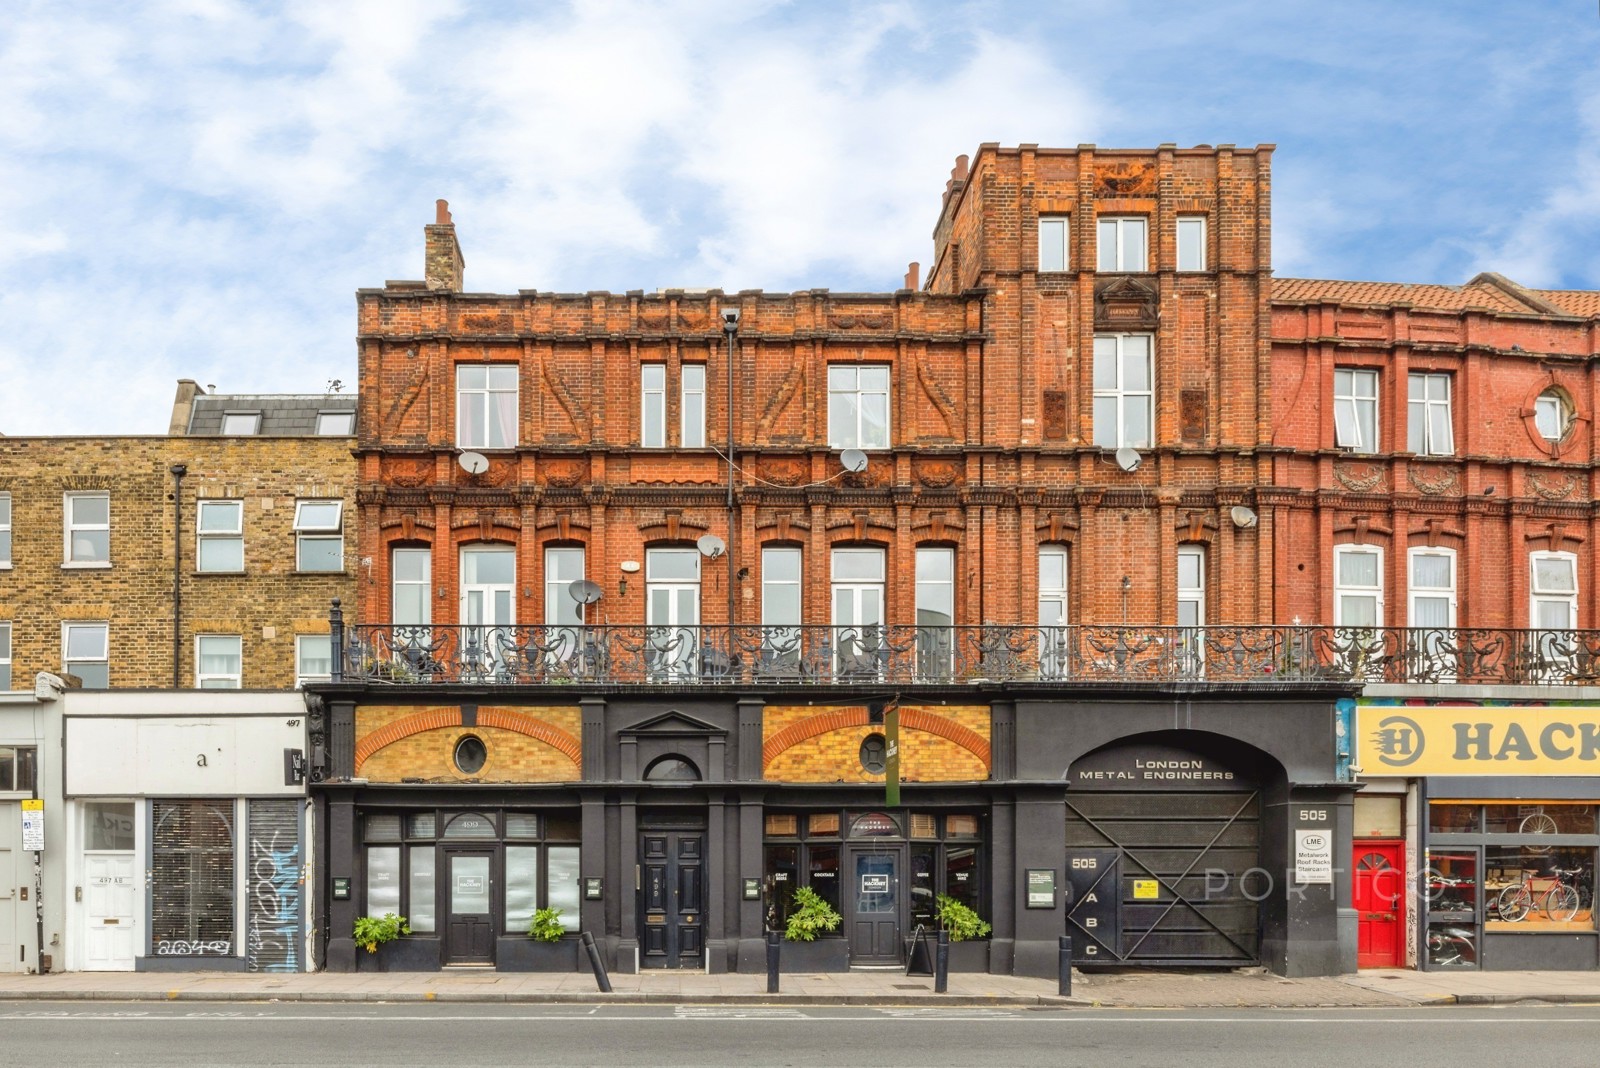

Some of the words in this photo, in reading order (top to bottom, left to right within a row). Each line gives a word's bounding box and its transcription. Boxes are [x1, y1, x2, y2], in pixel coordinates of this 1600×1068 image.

[286, 719, 300, 727] 497
[197, 753, 208, 767] a
[1079, 771, 1136, 779] METAL
[1143, 771, 1234, 780] ENGINEERS
[1299, 810, 1327, 821] 505
[1072, 858, 1097, 869] 505
[1085, 893, 1098, 903] A
[1085, 917, 1098, 927] B
[1085, 945, 1098, 955] C
